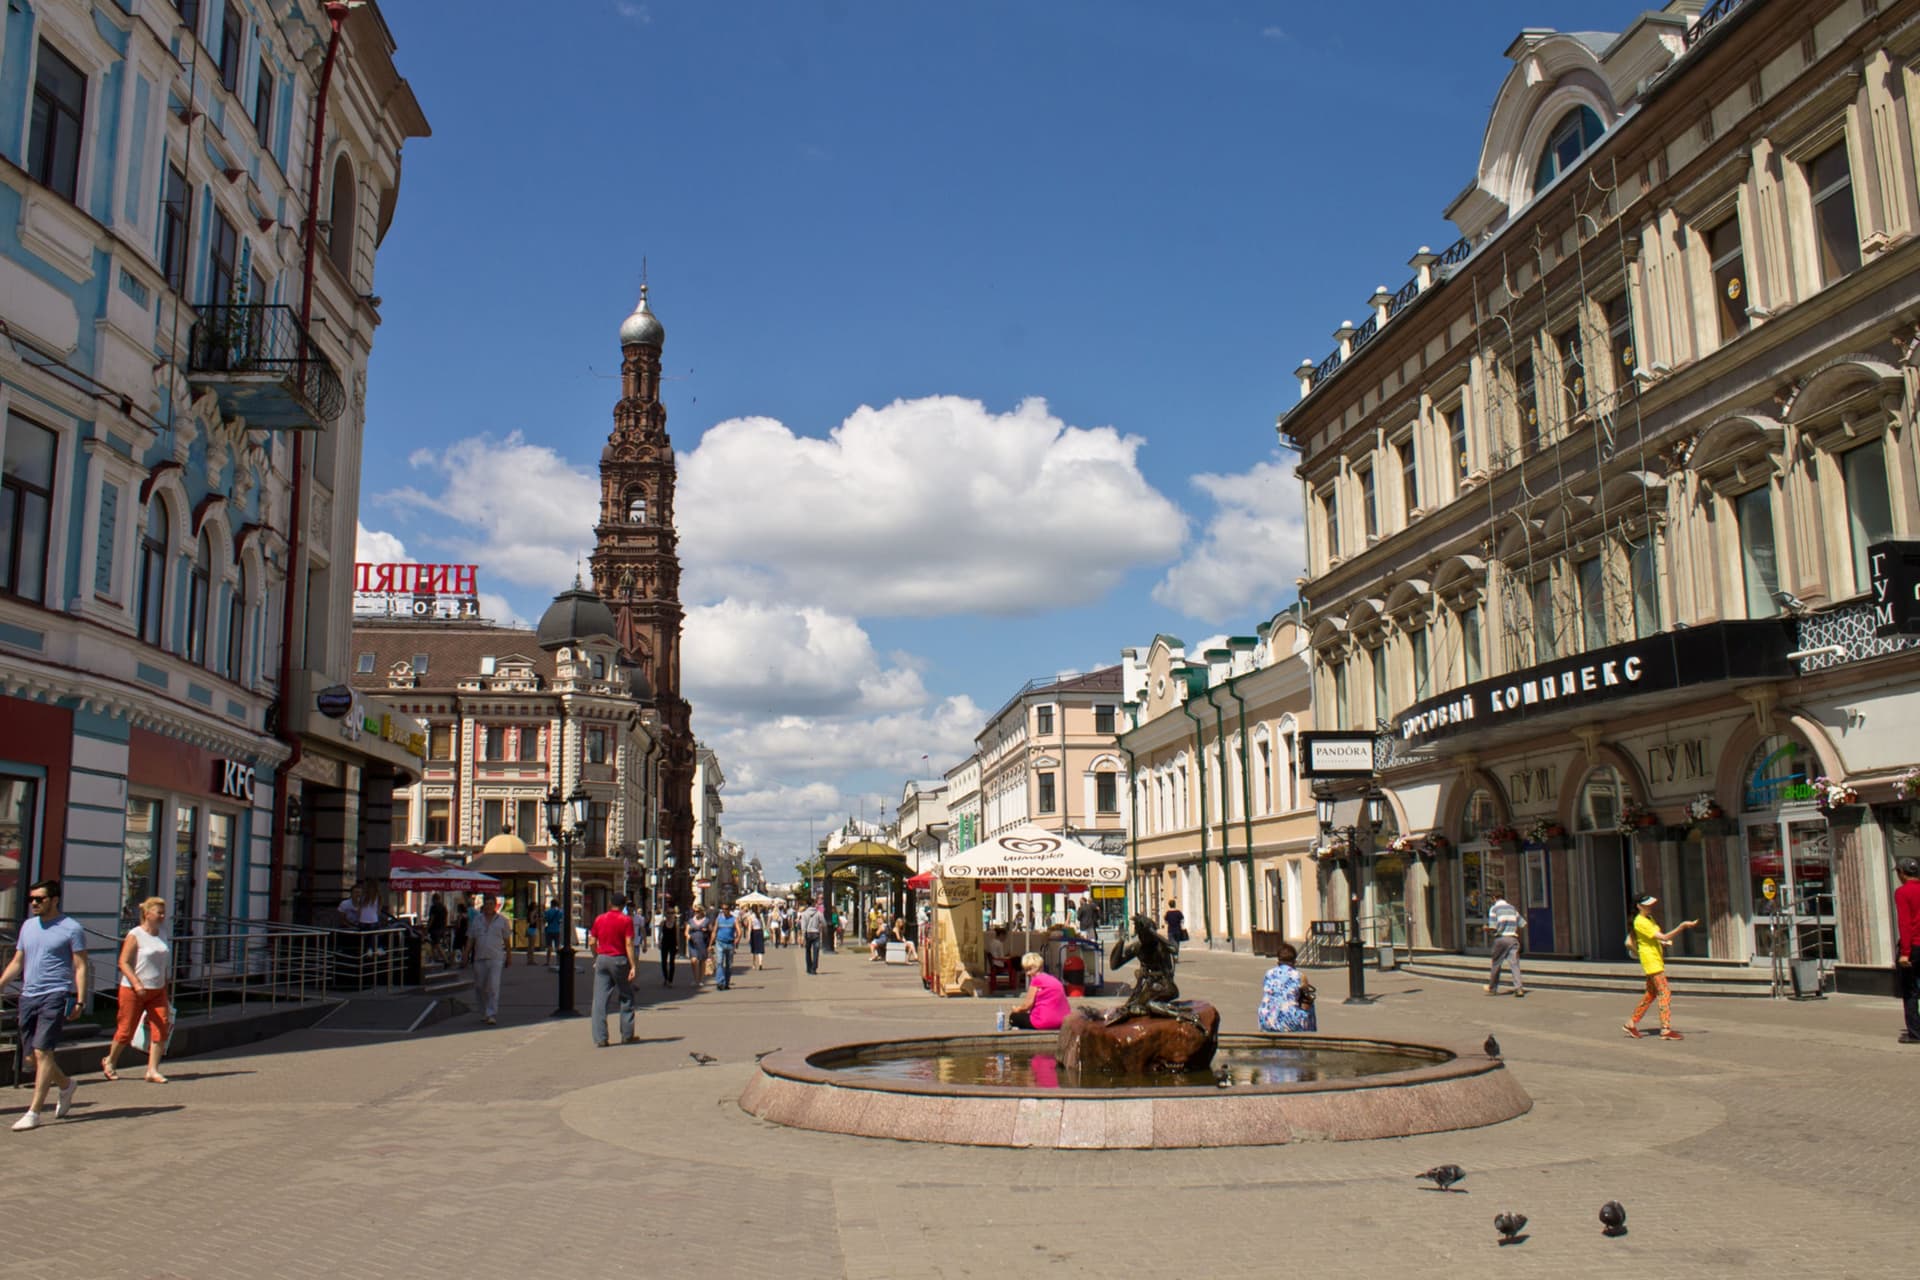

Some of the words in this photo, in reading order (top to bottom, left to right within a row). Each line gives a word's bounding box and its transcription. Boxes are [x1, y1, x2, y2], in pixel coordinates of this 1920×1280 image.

[1872, 553, 1896, 627] ГУМ
[1402, 694, 1475, 740] ТОРГОВЫЙ
[1491, 656, 1642, 712] КОМПЛЕКС
[1316, 747, 1367, 756] PANDORA
[1647, 737, 1713, 785] ГУМ
[222, 759, 255, 801] KFC
[1510, 765, 1557, 804] ГУМ
